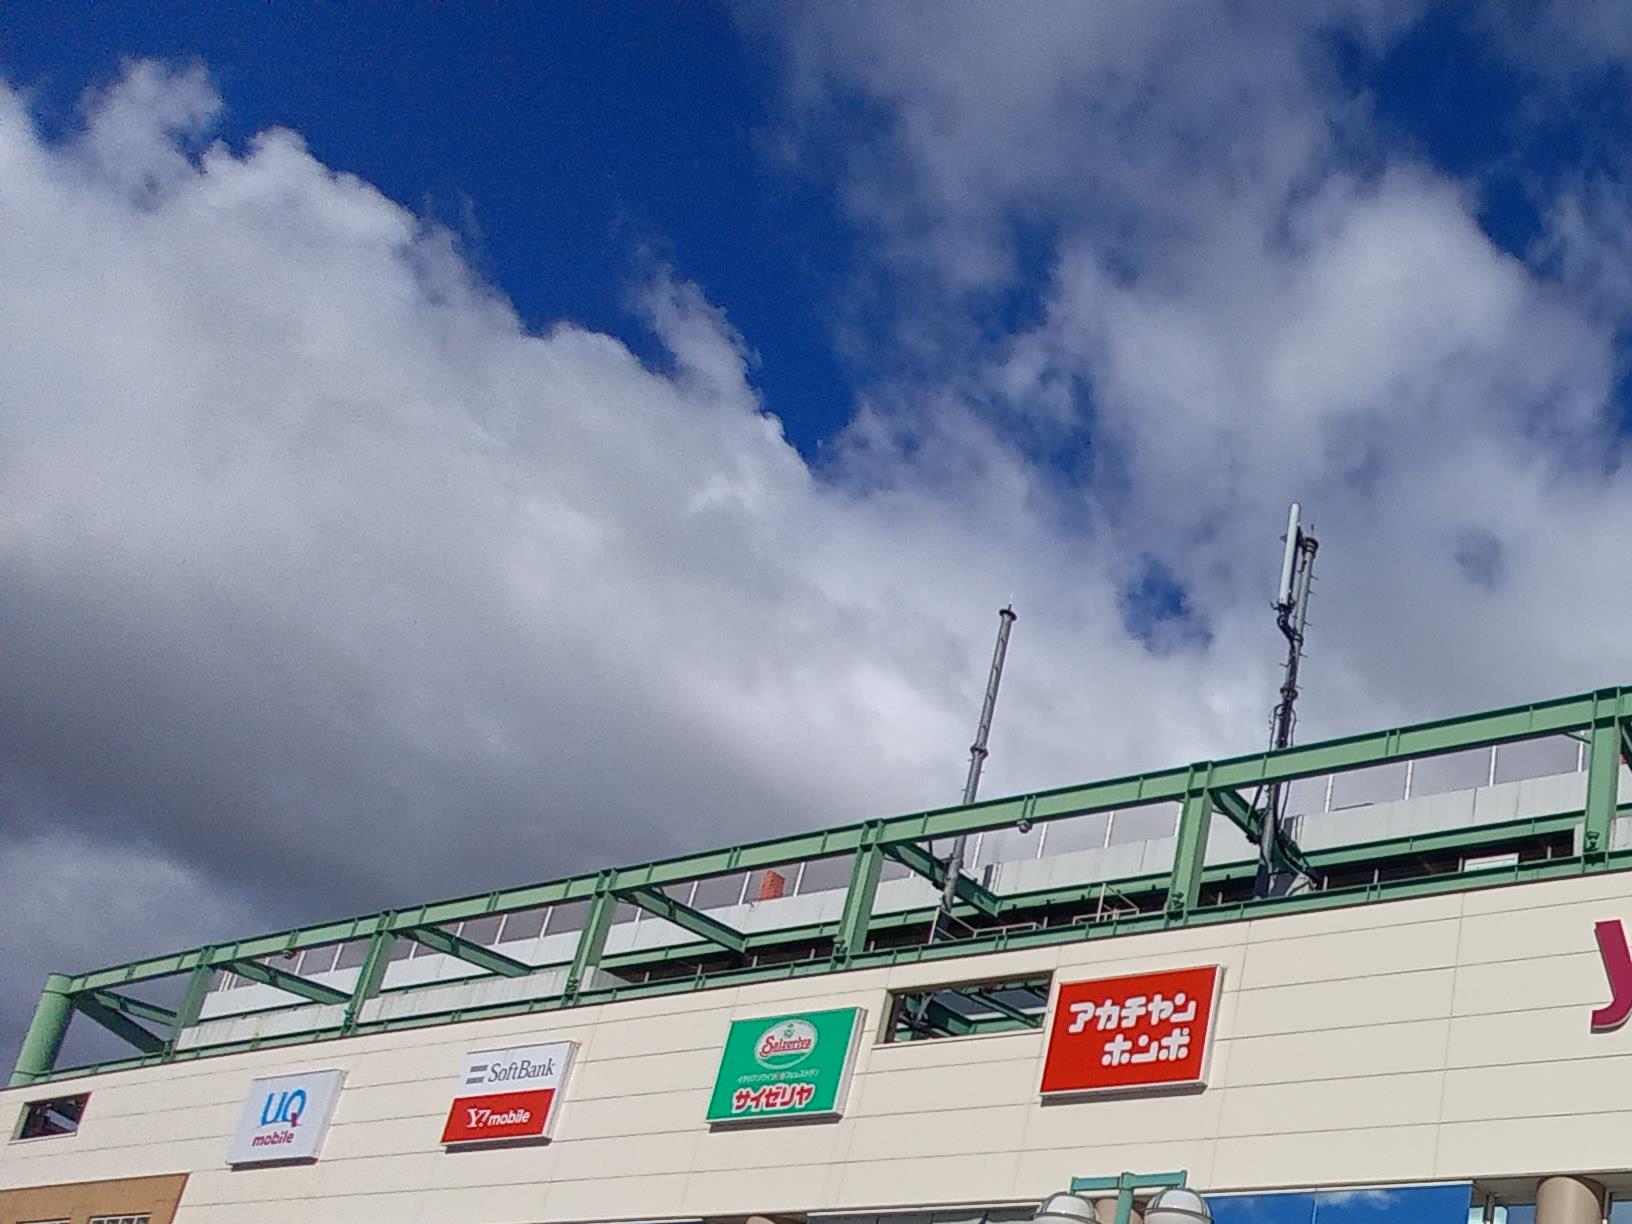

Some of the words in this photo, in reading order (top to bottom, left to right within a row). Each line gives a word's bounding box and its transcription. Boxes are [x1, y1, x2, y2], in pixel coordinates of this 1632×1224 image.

[1068, 993, 1197, 1033] アカチャン
[1101, 1028, 1190, 1066] ホンポ
[487, 1058, 556, 1084] SoftBank
[258, 1088, 308, 1128] UQ
[732, 1083, 815, 1113] サイゼリヤ
[251, 1130, 295, 1148] mobile
